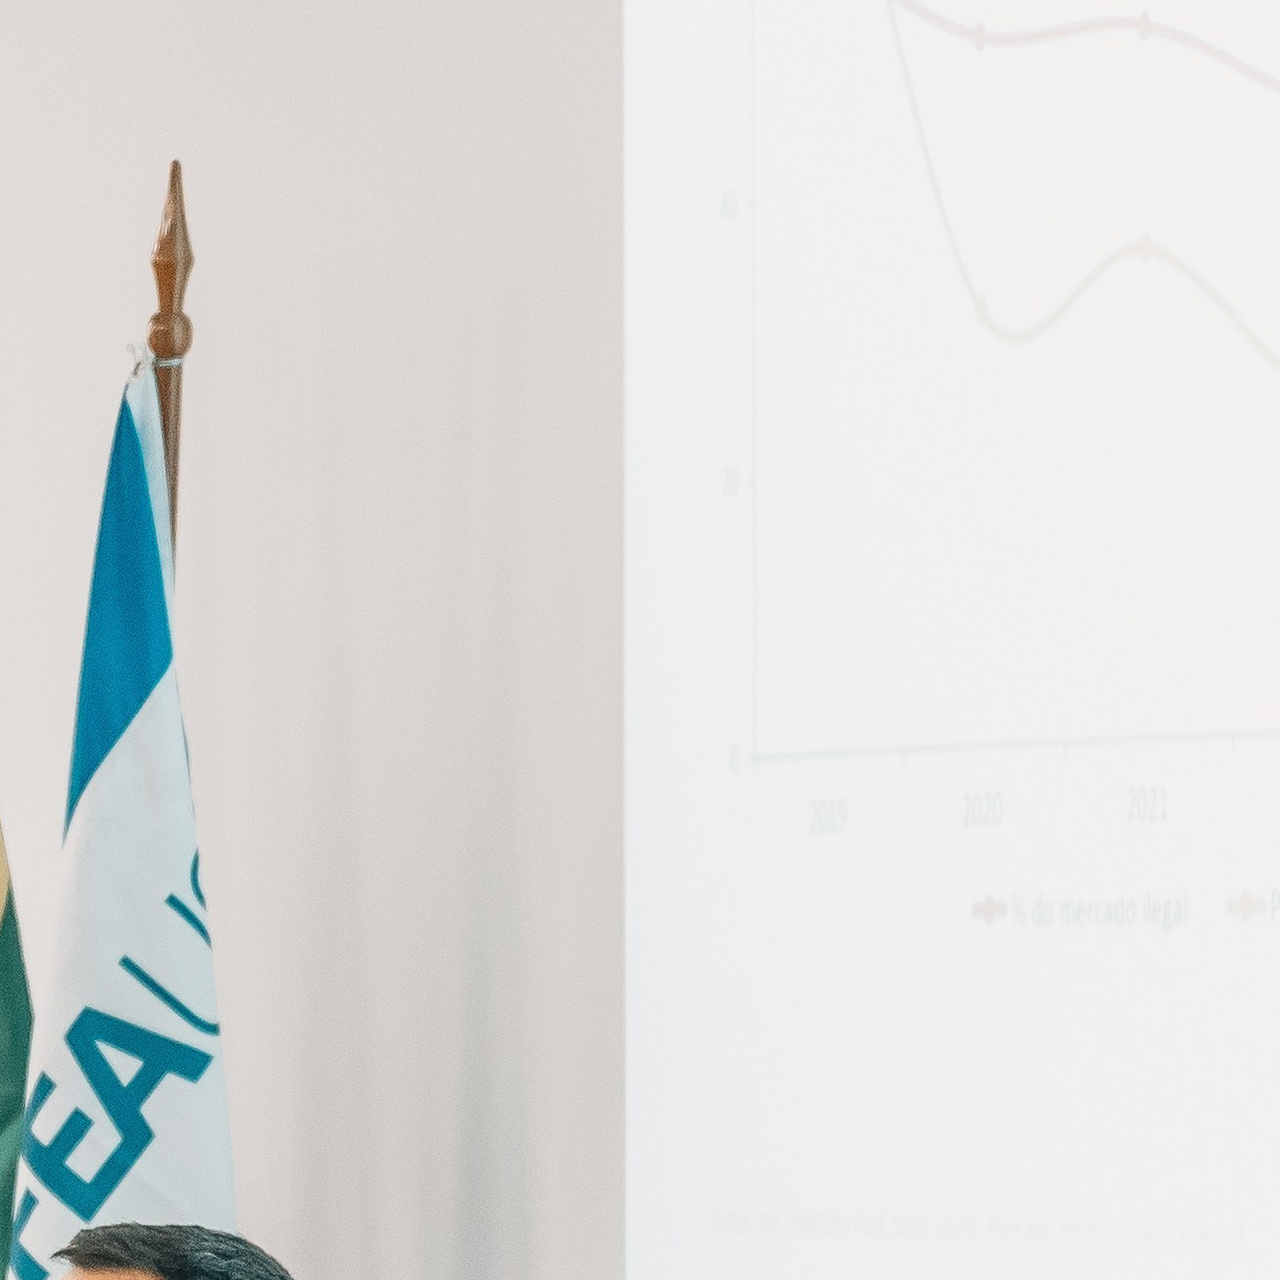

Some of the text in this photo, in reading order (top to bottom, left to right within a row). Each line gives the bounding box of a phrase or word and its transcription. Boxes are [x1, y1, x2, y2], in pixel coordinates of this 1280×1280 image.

[962, 791, 1003, 828] 2020
[1127, 785, 1168, 823] 2021
[1032, 891, 1054, 928] do
[1060, 889, 1137, 929] mercado
[1142, 888, 1188, 935] ilegal
